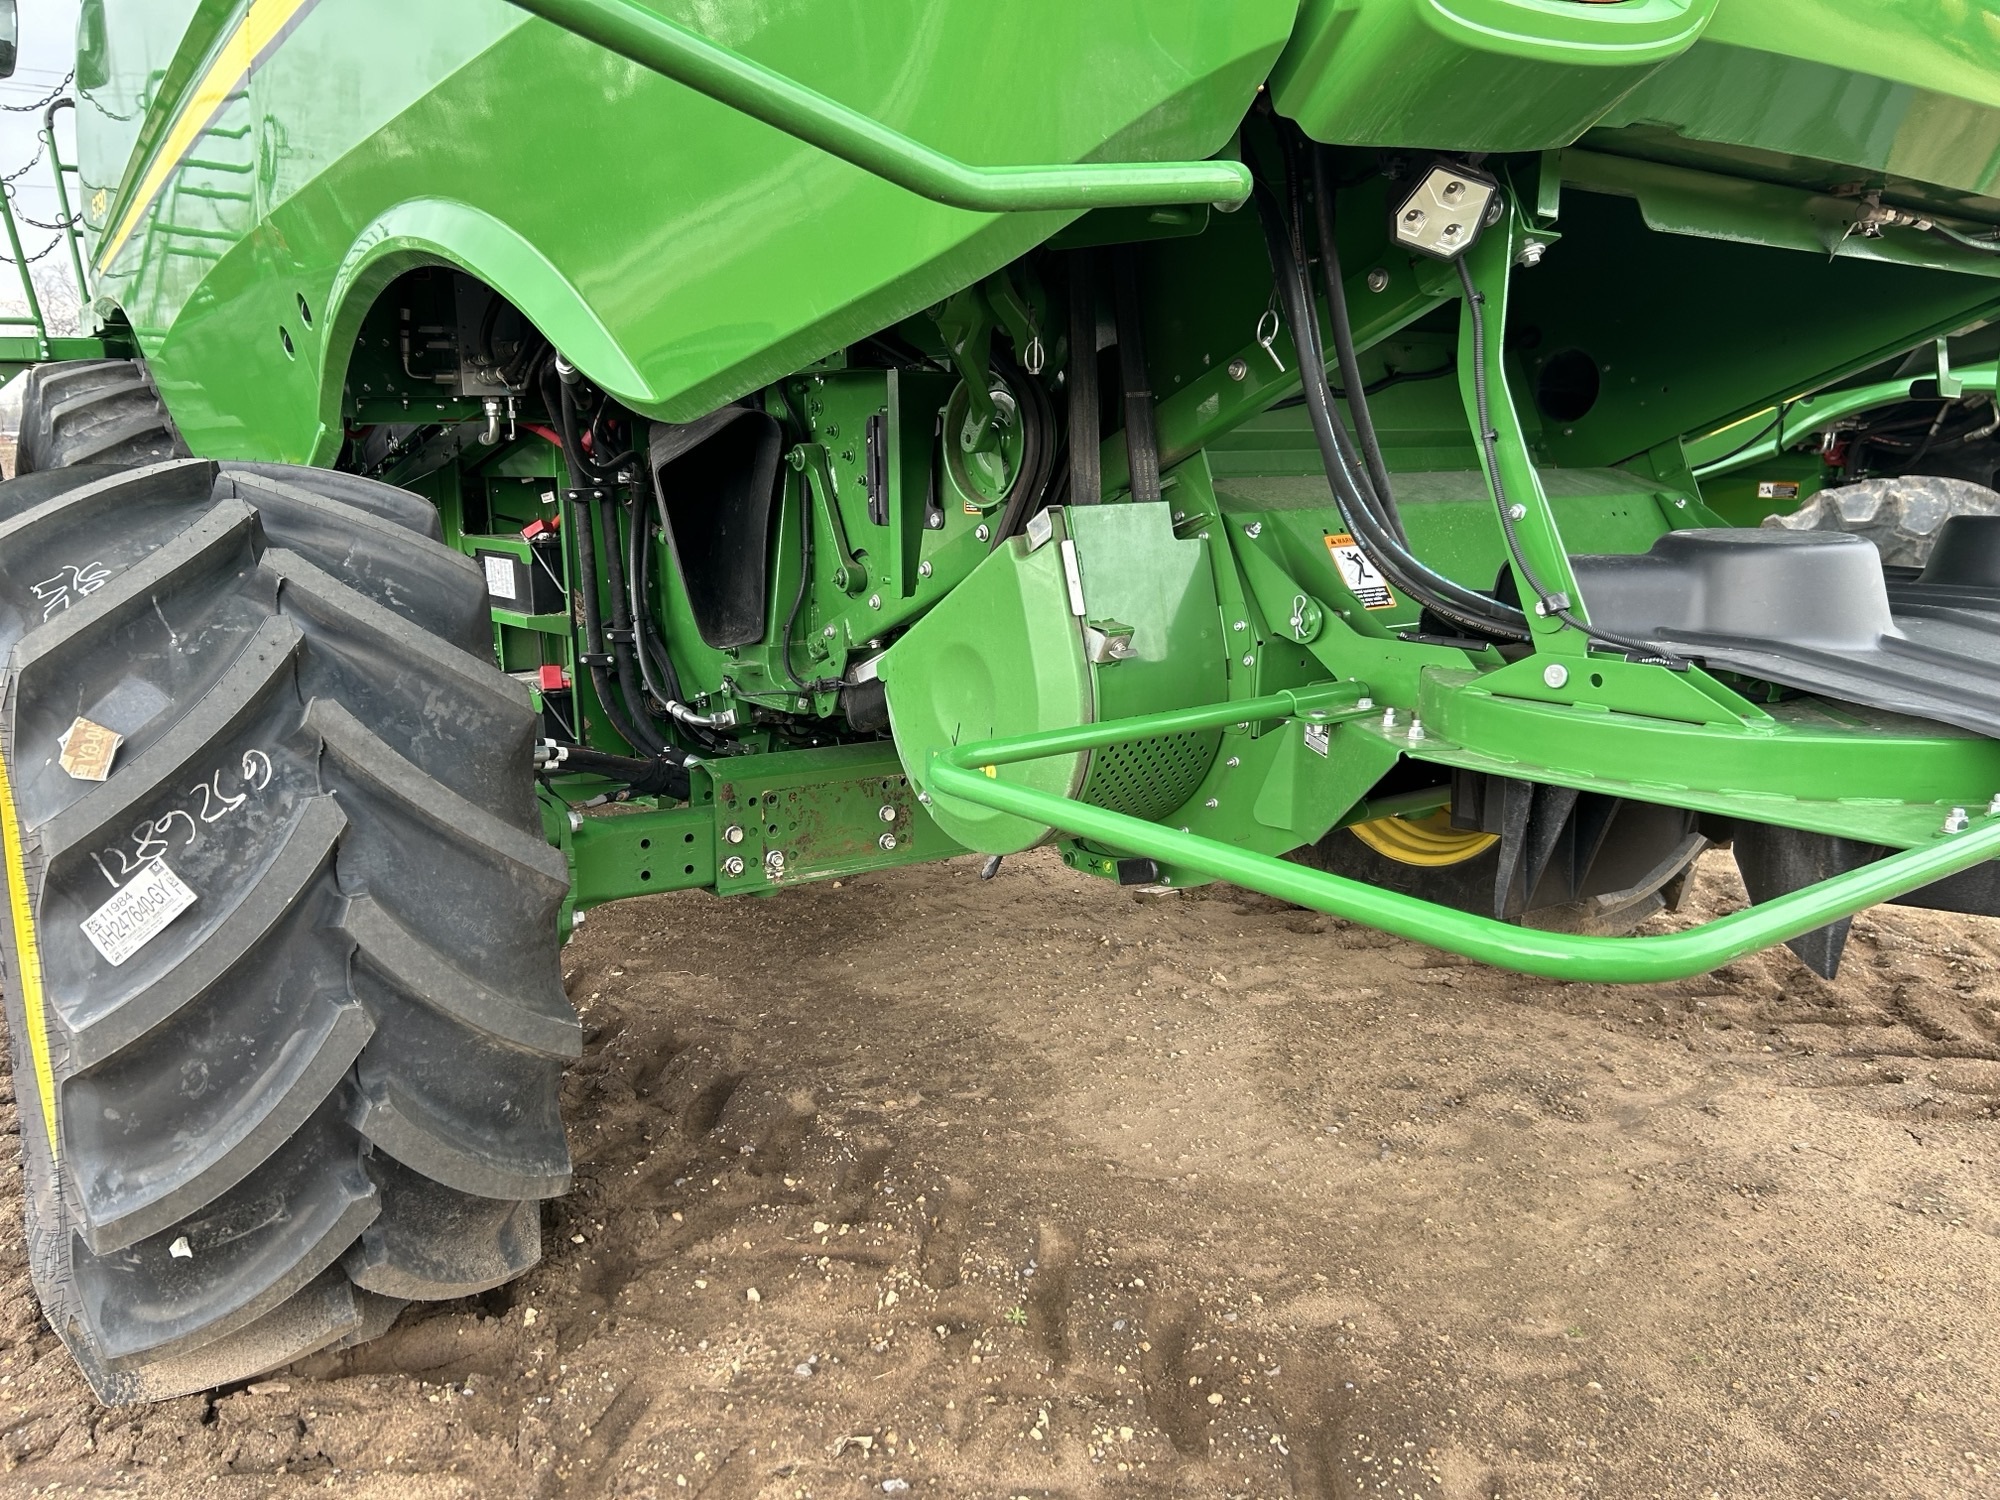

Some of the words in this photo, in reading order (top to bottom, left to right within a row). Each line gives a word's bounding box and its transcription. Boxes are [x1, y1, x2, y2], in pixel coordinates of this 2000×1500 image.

[1336, 537, 1354, 545] WARN
[97, 878, 171, 951] AH247640-GY
[100, 891, 134, 921] 11984
